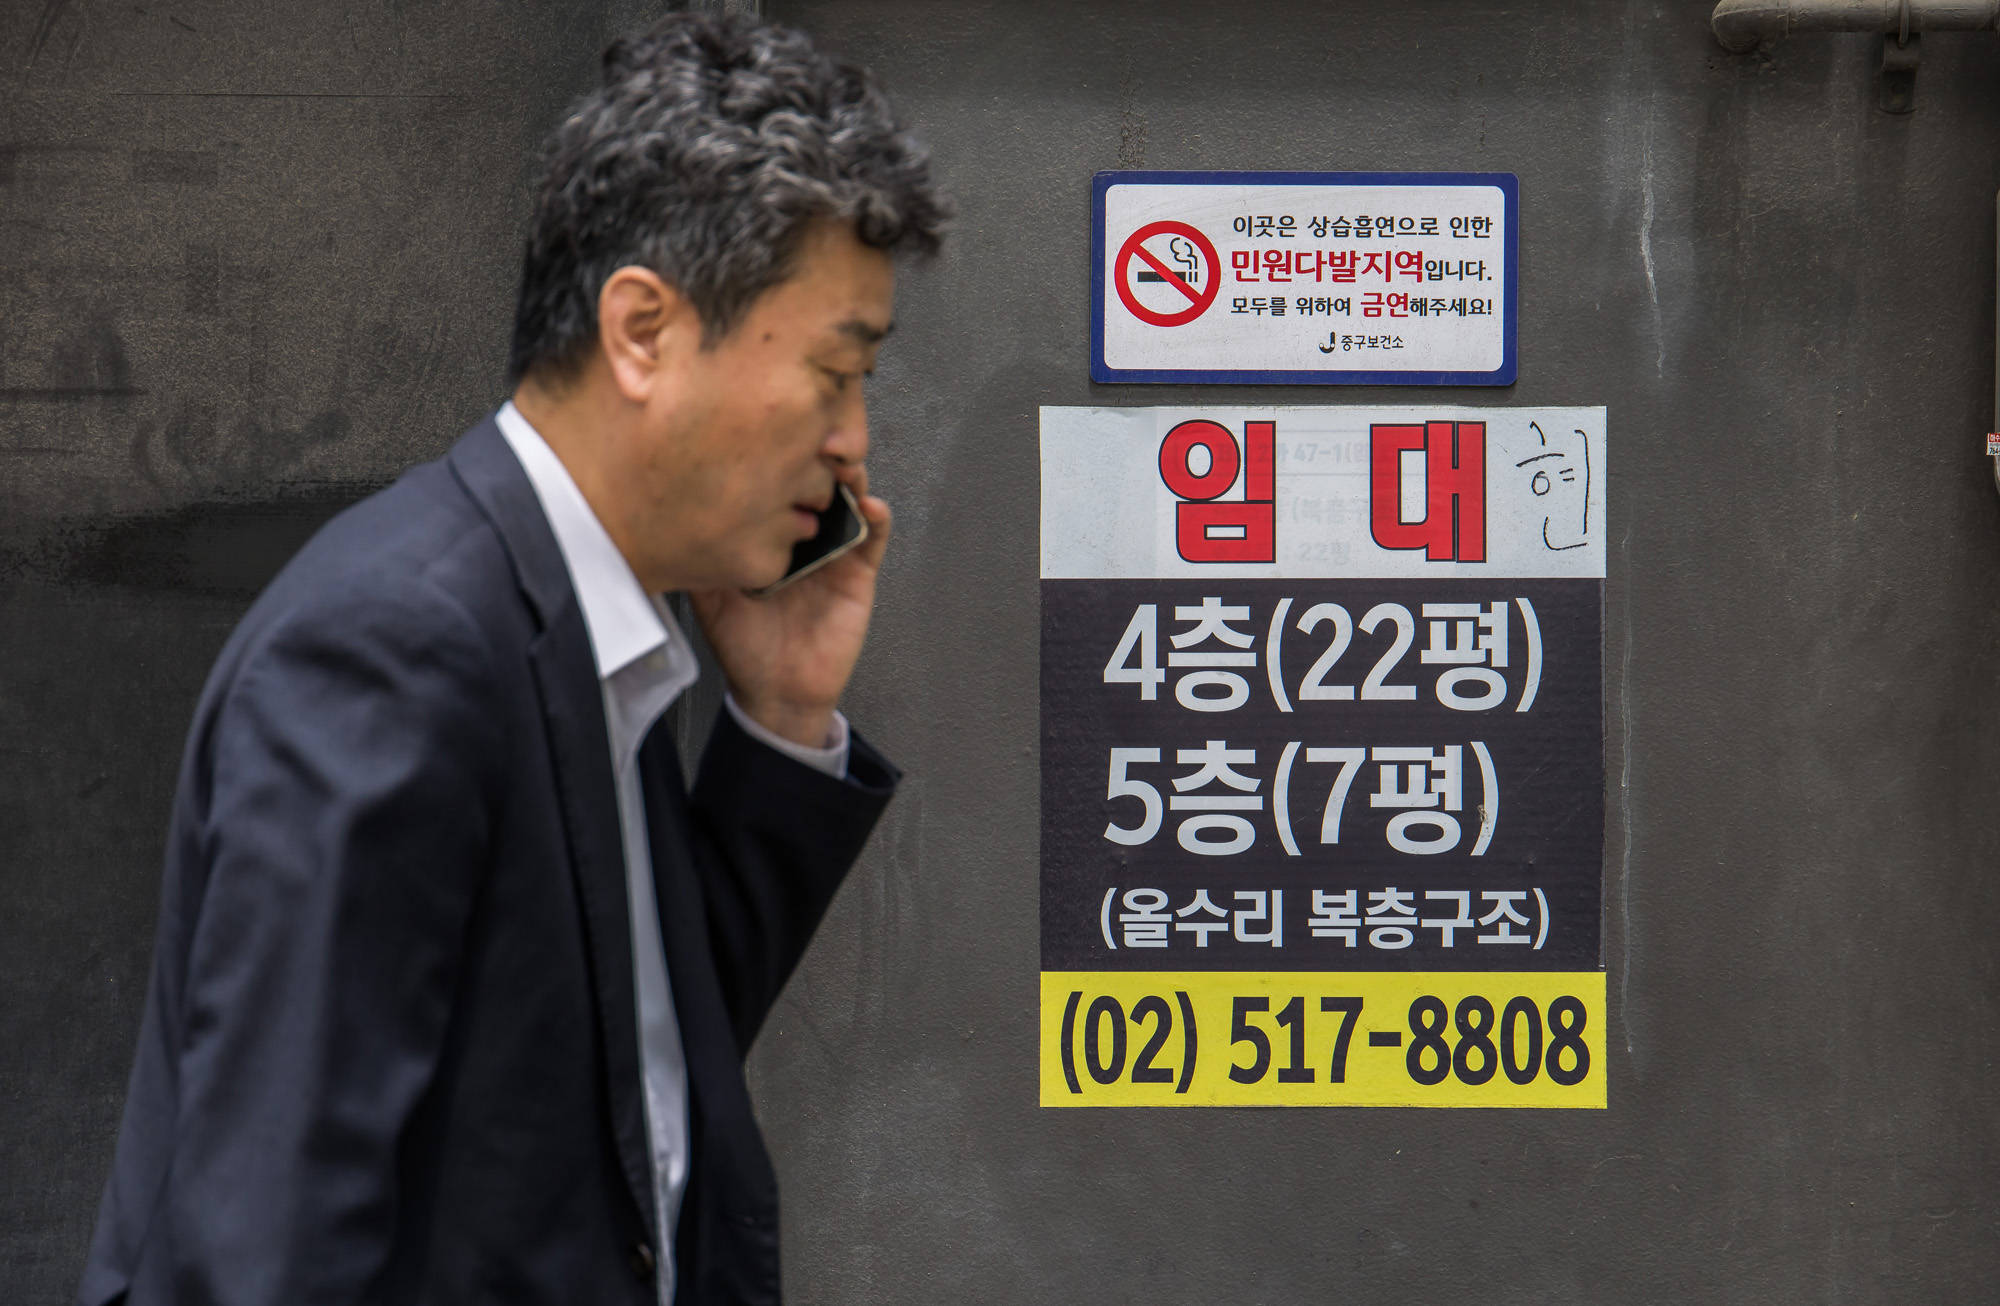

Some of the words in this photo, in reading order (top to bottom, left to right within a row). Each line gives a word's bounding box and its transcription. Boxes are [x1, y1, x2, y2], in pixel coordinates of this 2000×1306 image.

[1233, 216, 1297, 237] 이곳은
[1307, 216, 1439, 238] 상습흡연으로
[1449, 216, 1493, 238] 인한
[1231, 249, 1492, 282] 민원다발지역입니다.
[1231, 296, 1287, 316] 모두를
[1296, 296, 1351, 316] 위하여
[1360, 292, 1493, 318] 금연해주세요!
[1340, 335, 1404, 351] 중구보건소
[1103, 597, 1543, 712] 4층(22평)
[1103, 740, 1499, 856] 5층(7평)
[1101, 887, 1283, 949] (올수리
[1308, 887, 1550, 949] 복층구조)
[1060, 991, 1197, 1093] (02)
[1228, 995, 1591, 1086] 517-8808
